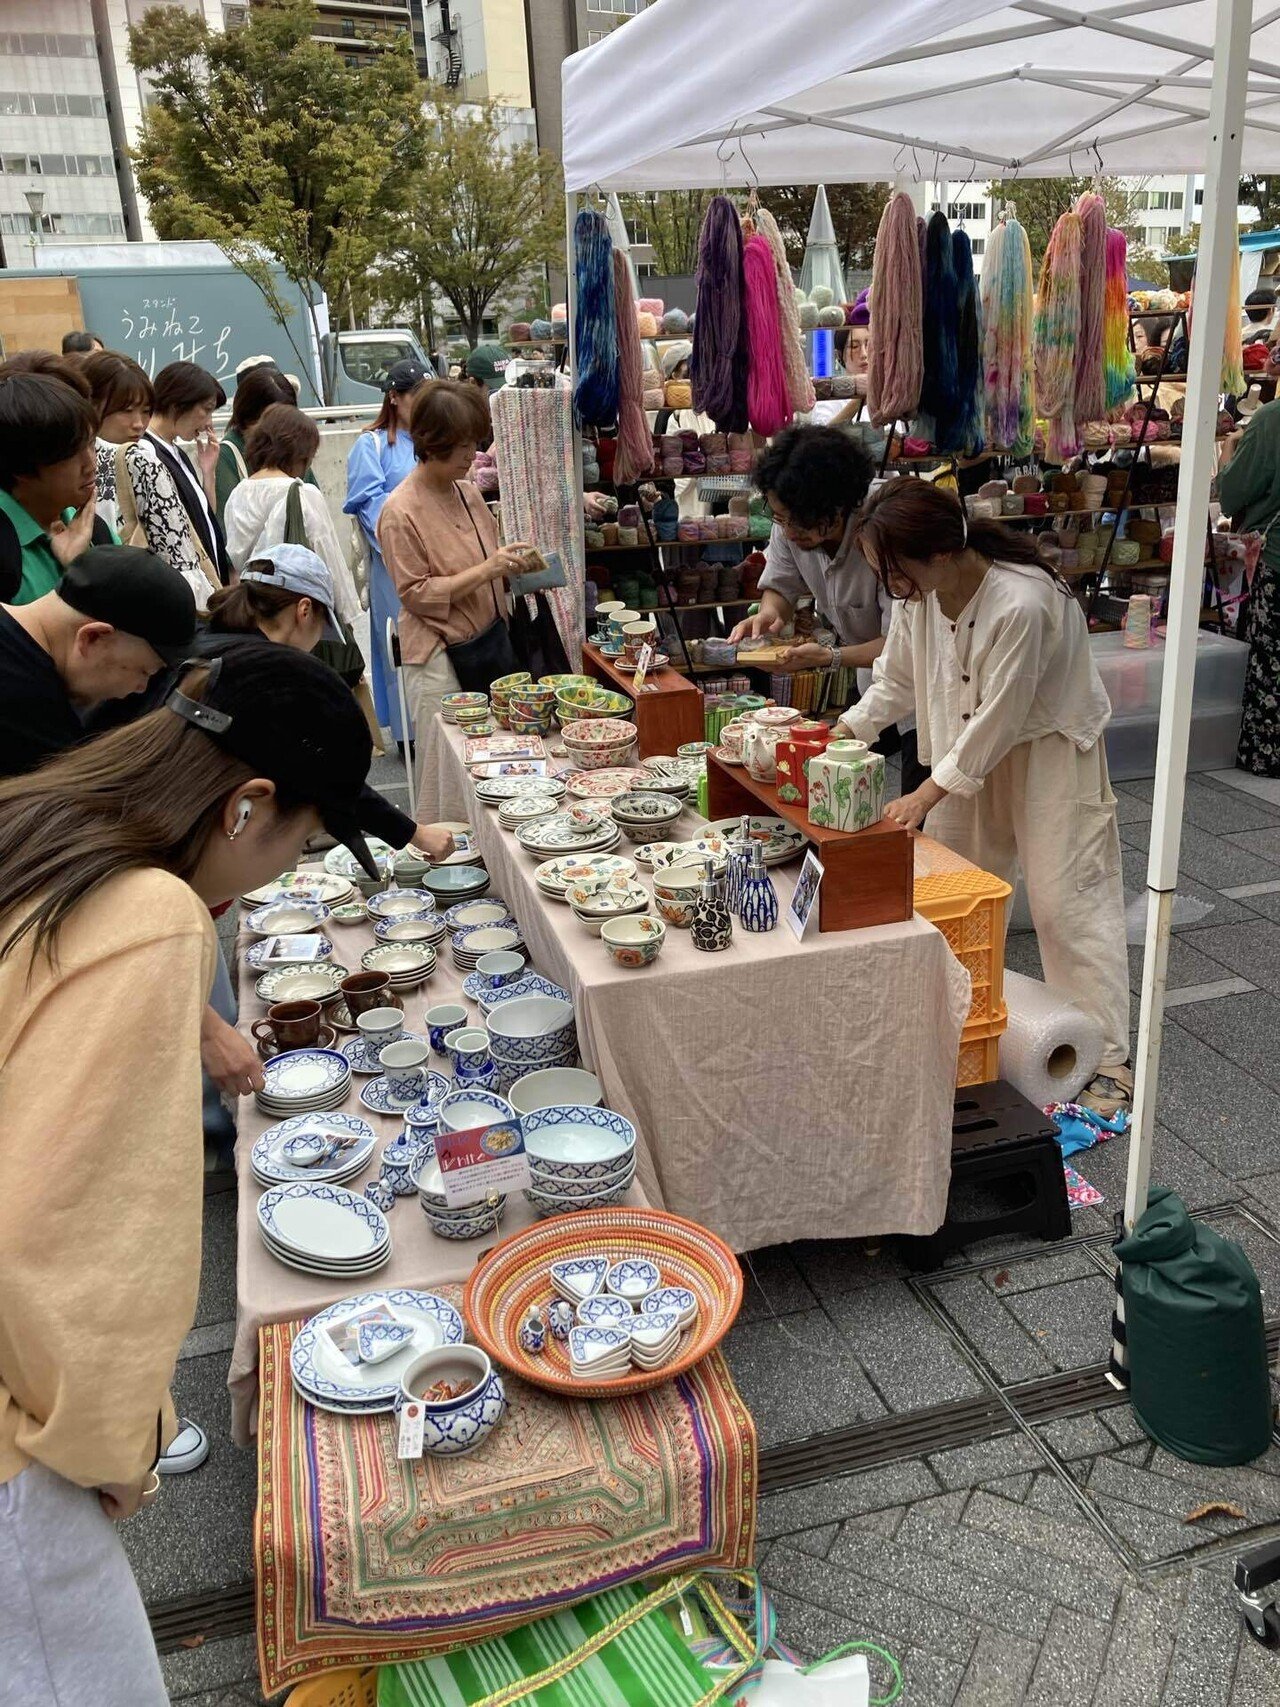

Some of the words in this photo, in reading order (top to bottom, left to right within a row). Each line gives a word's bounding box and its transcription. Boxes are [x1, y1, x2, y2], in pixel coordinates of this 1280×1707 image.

[142, 298, 176, 309] スタンド
[121, 307, 204, 340] うみねこ
